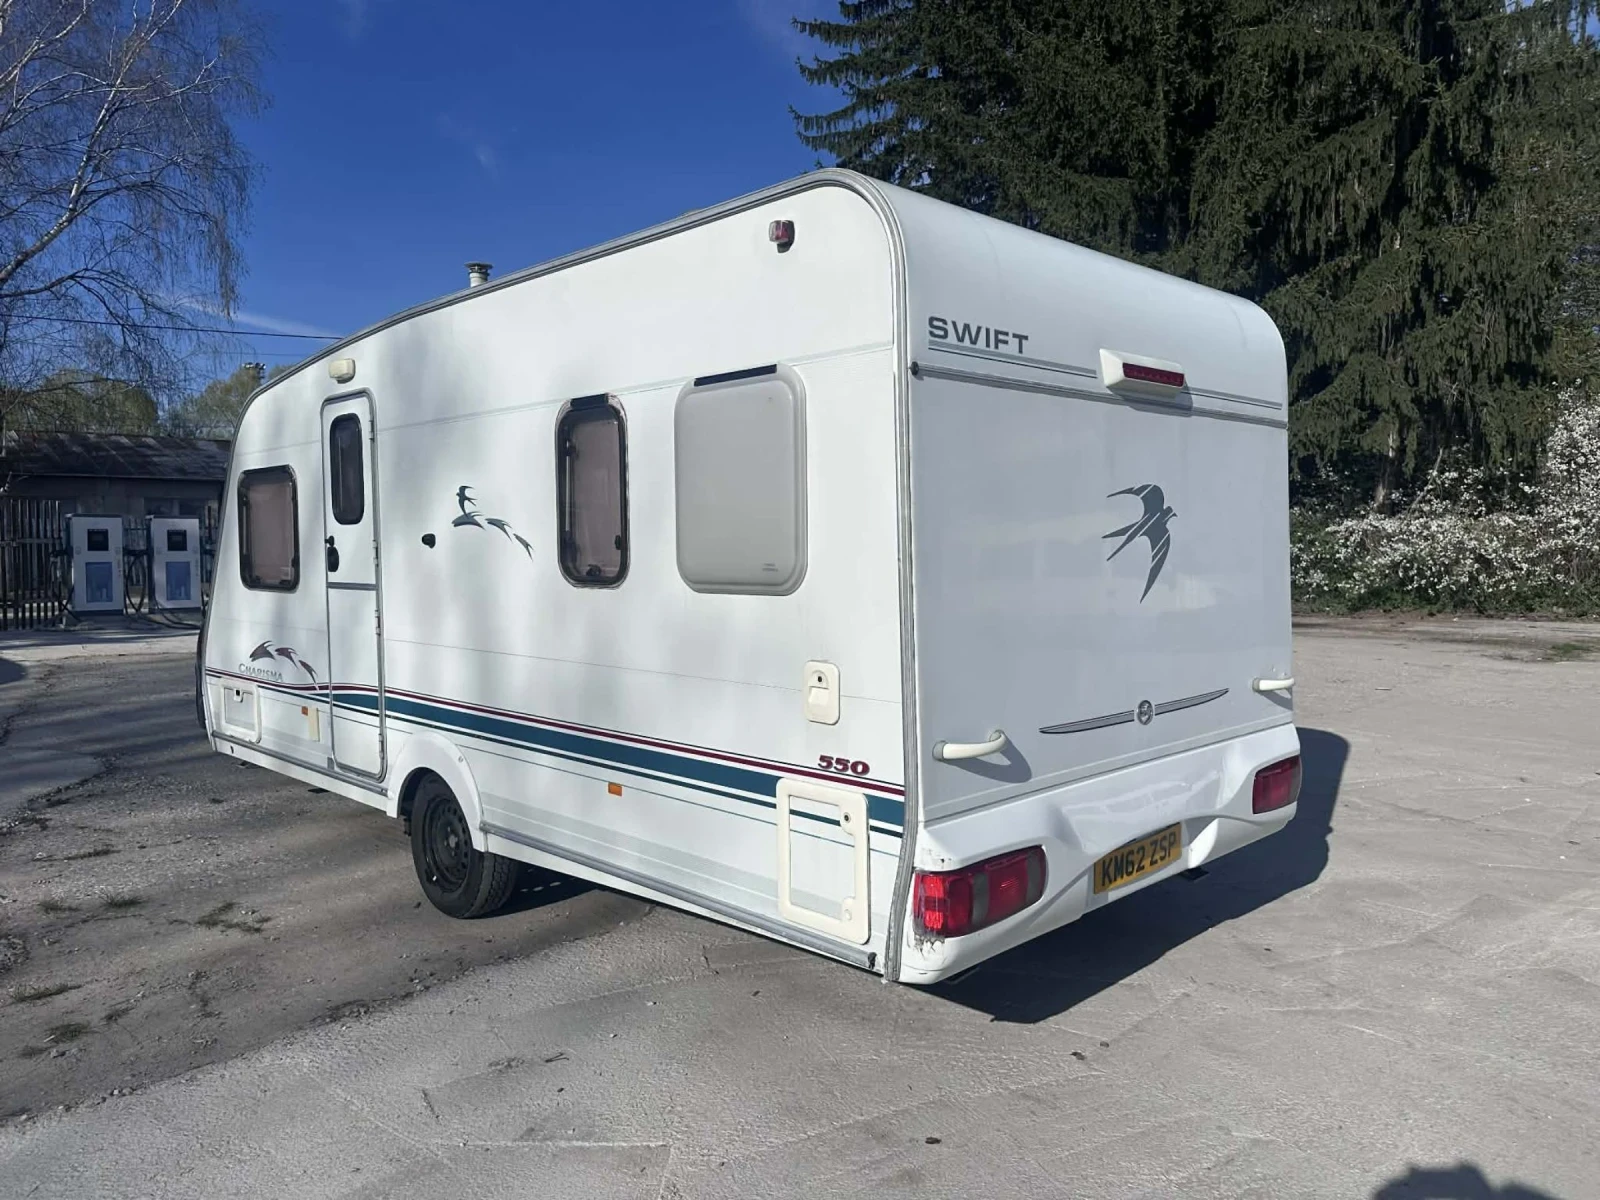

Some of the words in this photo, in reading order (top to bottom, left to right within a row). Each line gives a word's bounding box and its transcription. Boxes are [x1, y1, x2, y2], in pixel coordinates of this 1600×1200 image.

[928, 316, 1029, 354] SWIFT
[818, 755, 870, 776] 550
[1101, 845, 1146, 887] KM62
[1149, 831, 1177, 867] ZSP
